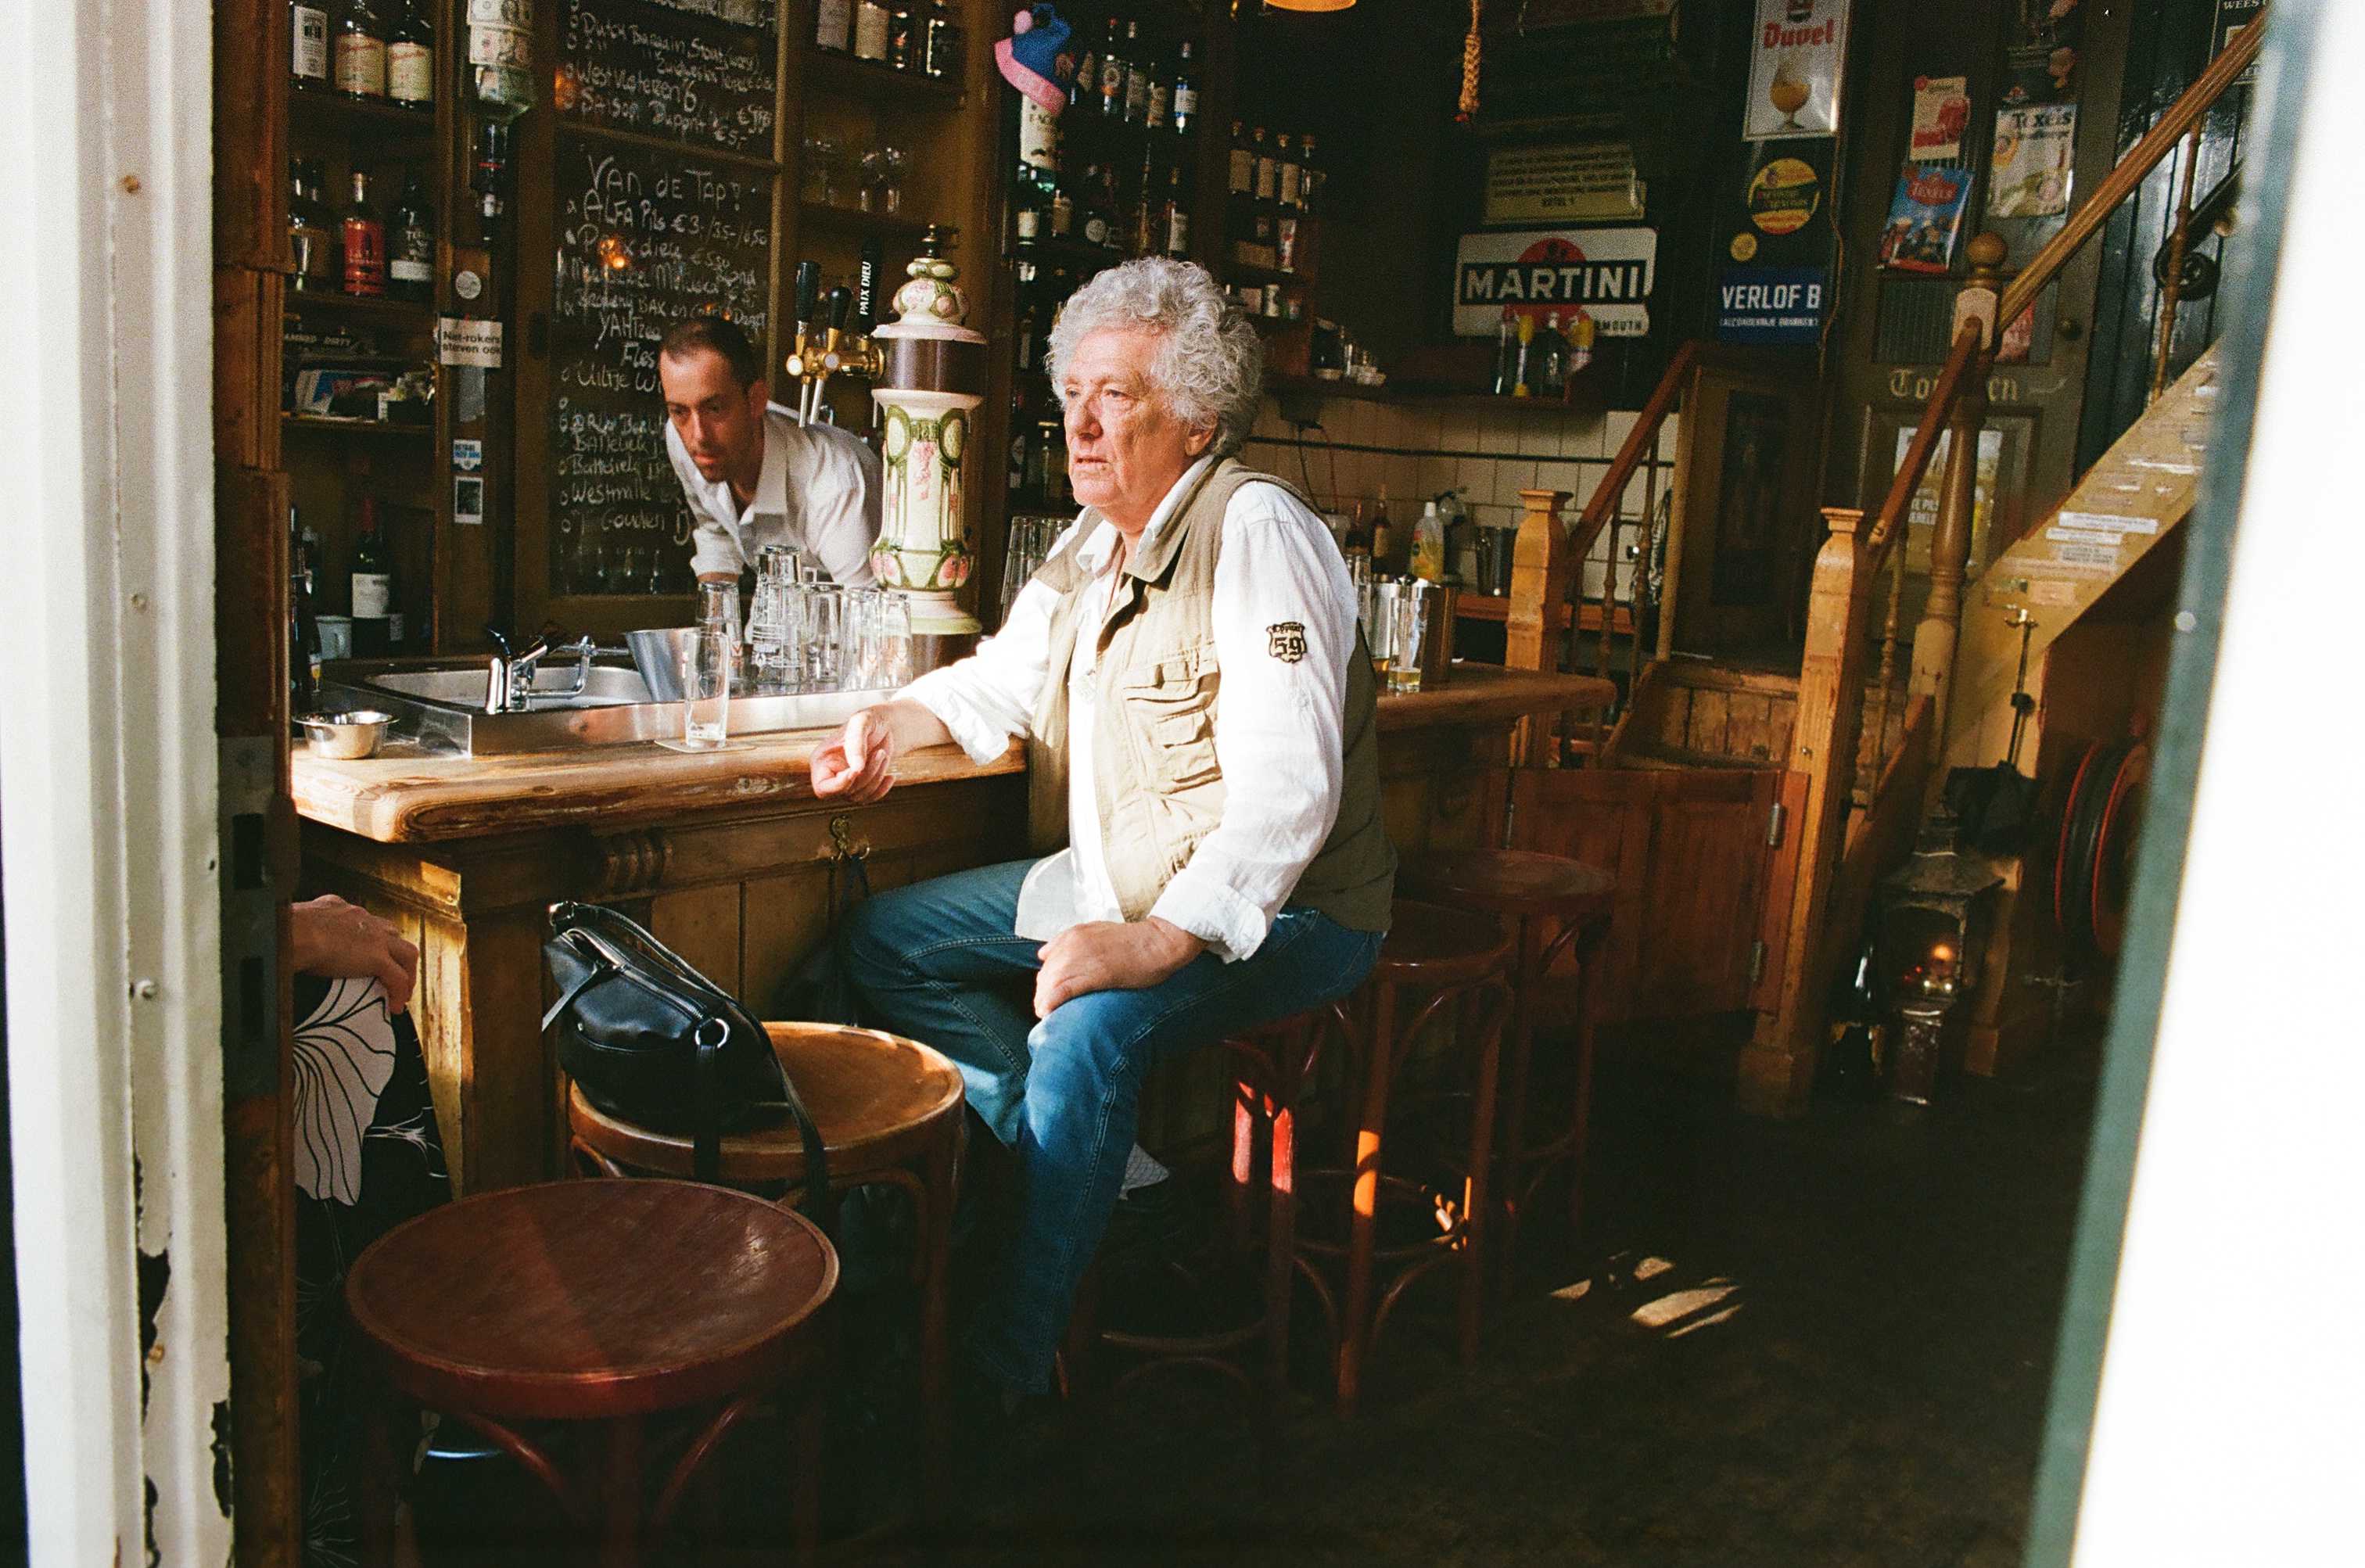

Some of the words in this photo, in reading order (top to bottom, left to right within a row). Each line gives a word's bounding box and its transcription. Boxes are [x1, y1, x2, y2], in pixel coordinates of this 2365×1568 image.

[1764, 19, 1835, 48] Duvel
[861, 260, 872, 287] DIEU
[1465, 267, 1639, 300] MARTINI
[860, 288, 870, 316] PAIX
[1722, 284, 1802, 310] VERLOF
[1807, 283, 1821, 310] B
[443, 343, 479, 354] sterven
[1275, 637, 1302, 657] 59
